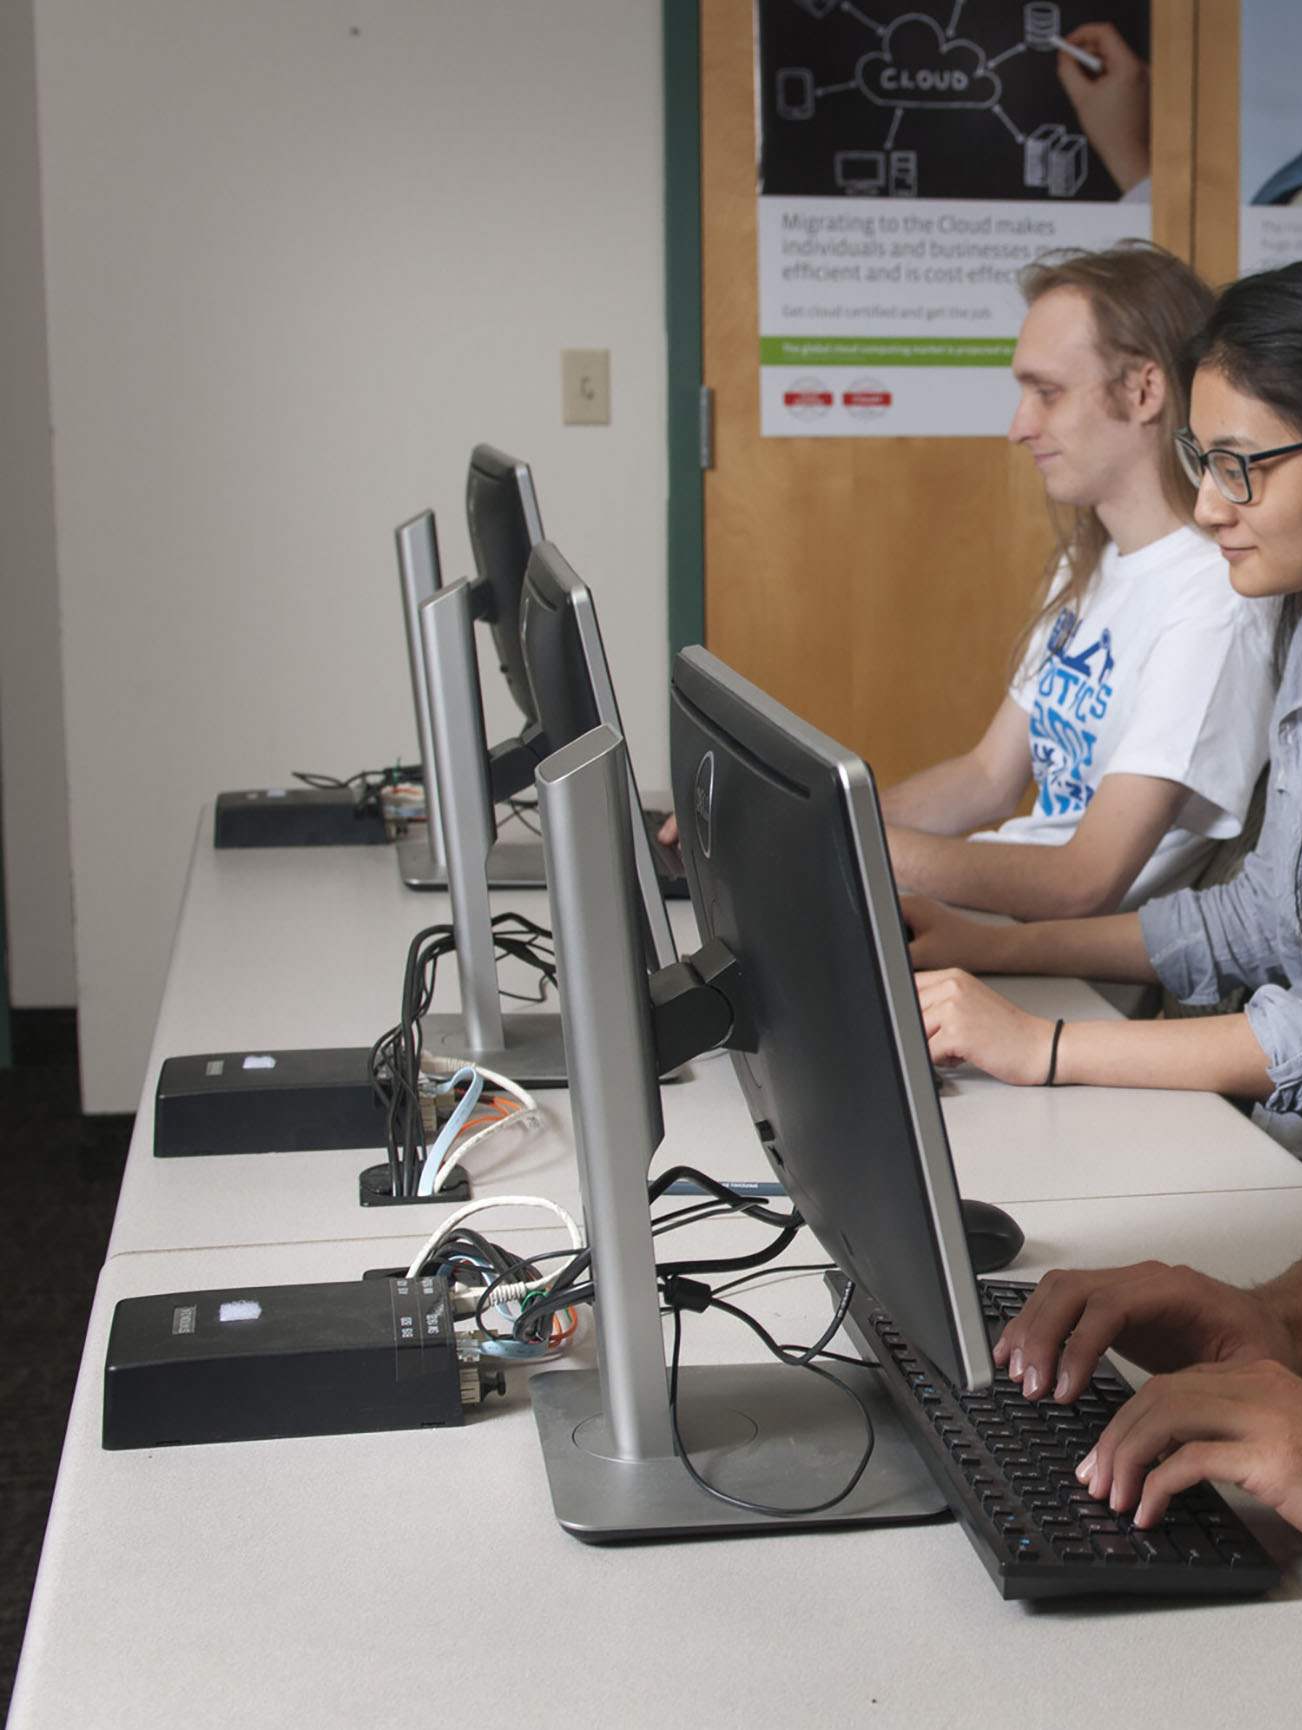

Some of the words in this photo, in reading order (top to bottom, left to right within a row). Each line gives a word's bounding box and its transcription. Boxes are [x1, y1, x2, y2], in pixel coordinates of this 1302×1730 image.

[879, 66, 970, 91] CLOUD
[781, 212, 876, 236] Migrating
[878, 215, 900, 233] to
[903, 213, 935, 233] the
[937, 215, 992, 235] Cloud
[995, 217, 1056, 235] makes
[781, 238, 886, 256] individuals
[889, 239, 927, 257] and
[930, 240, 1030, 258] businesses
[781, 263, 862, 282] efficient
[864, 264, 902, 282] and
[905, 265, 920, 282] is
[923, 267, 963, 284] cost
